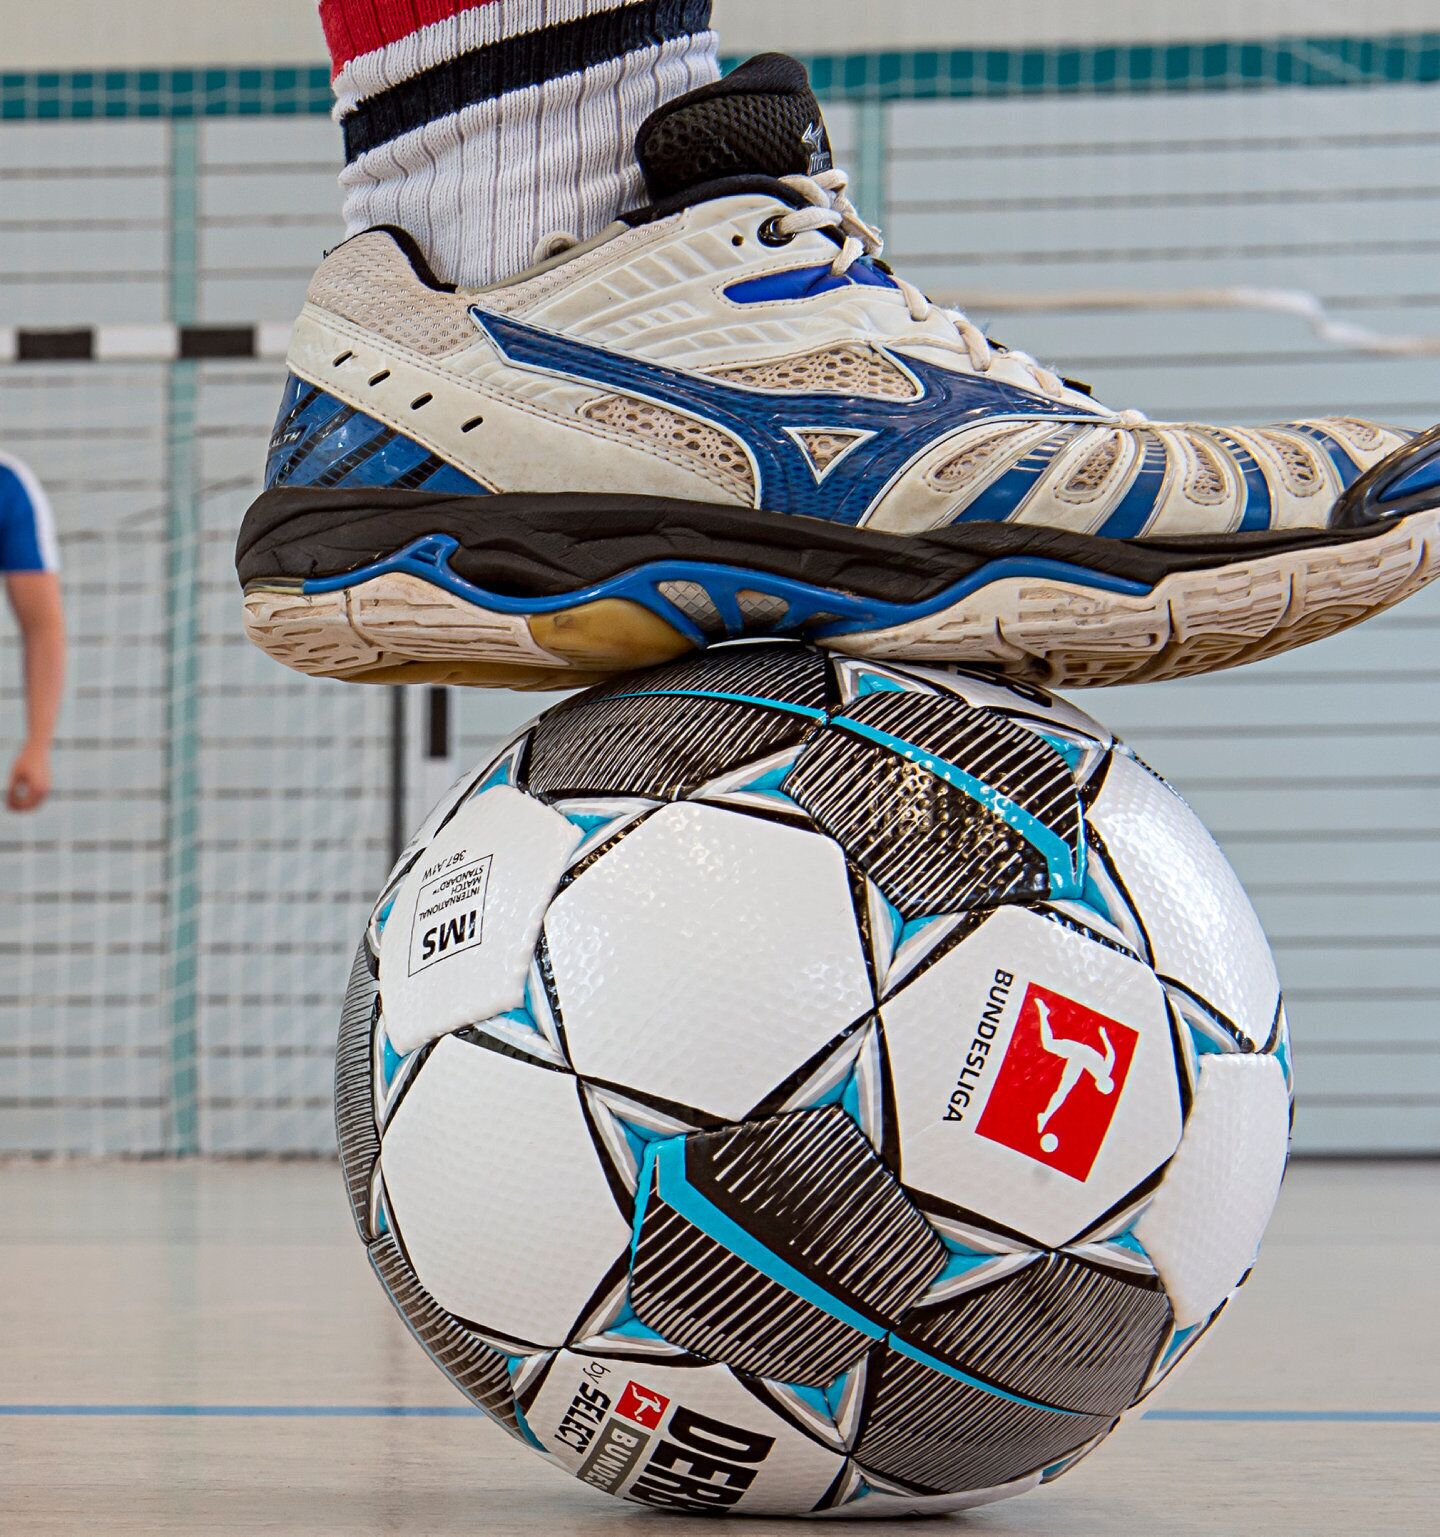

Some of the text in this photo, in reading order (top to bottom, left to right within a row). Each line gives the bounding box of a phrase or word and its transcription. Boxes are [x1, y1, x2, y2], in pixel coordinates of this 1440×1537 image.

[419, 885, 480, 922] INTERNATIONAL
[451, 875, 482, 896] MATCH
[422, 909, 477, 961] IMS
[942, 968, 1014, 1122] BUNDESLIGA
[554, 1361, 612, 1455] by SELECT
[623, 1405, 776, 1512] DERB
